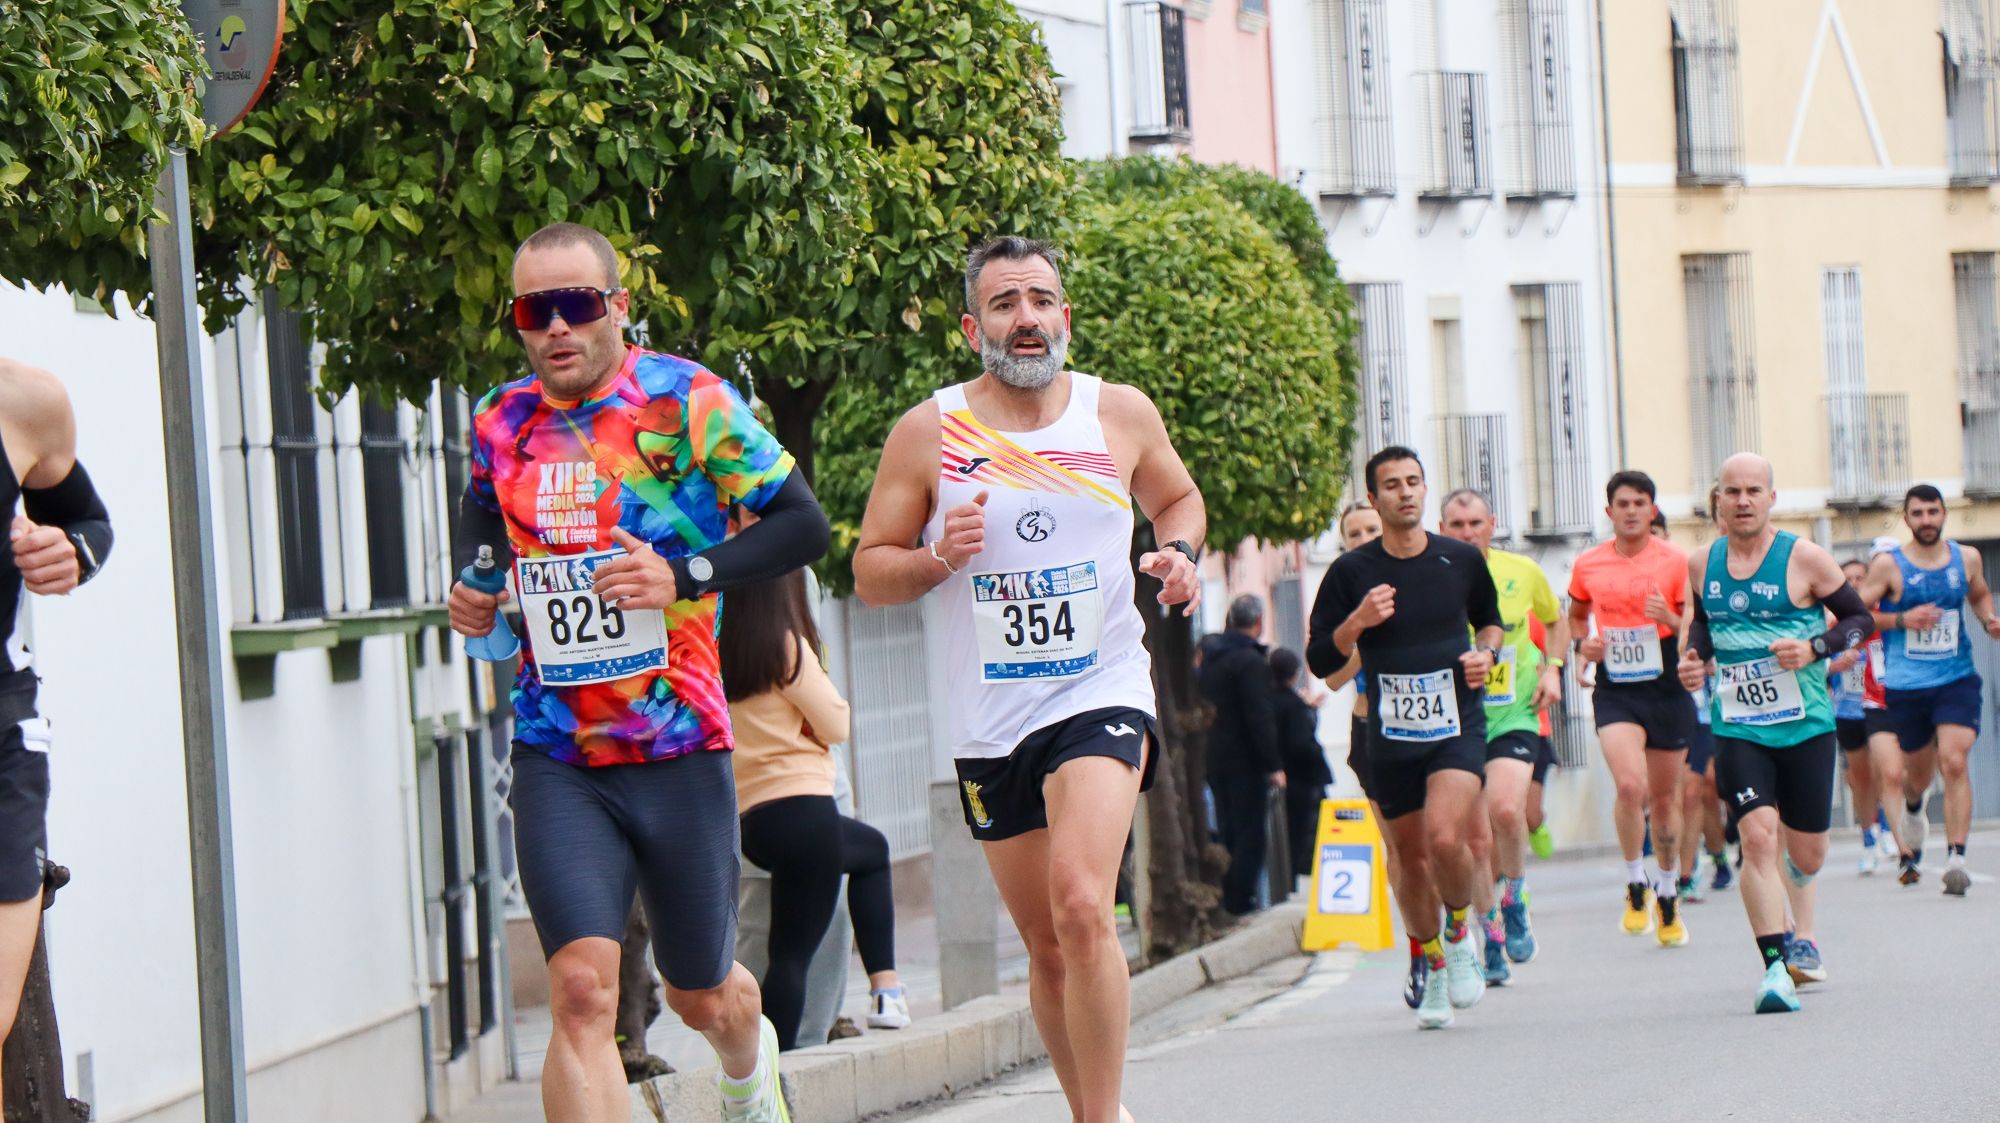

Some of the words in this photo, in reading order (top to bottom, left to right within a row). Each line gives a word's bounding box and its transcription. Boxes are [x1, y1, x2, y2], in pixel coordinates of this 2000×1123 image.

[537, 462, 574, 494] XII
[575, 461, 597, 482] 08
[537, 494, 576, 511] MEDIA
[575, 492, 597, 504] 2026
[537, 507, 598, 528] MARATÓN
[545, 528, 569, 545] 10K
[570, 534, 598, 544] LUCENA
[531, 561, 574, 593] 21K
[989, 573, 1031, 600] 21K
[547, 594, 625, 646] 825
[1003, 600, 1075, 646] 354
[1612, 644, 1645, 664] 500
[1736, 679, 1779, 706] 485
[1392, 694, 1445, 721] 1234
[1323, 848, 1343, 860] km
[1332, 871, 1353, 899] 2
